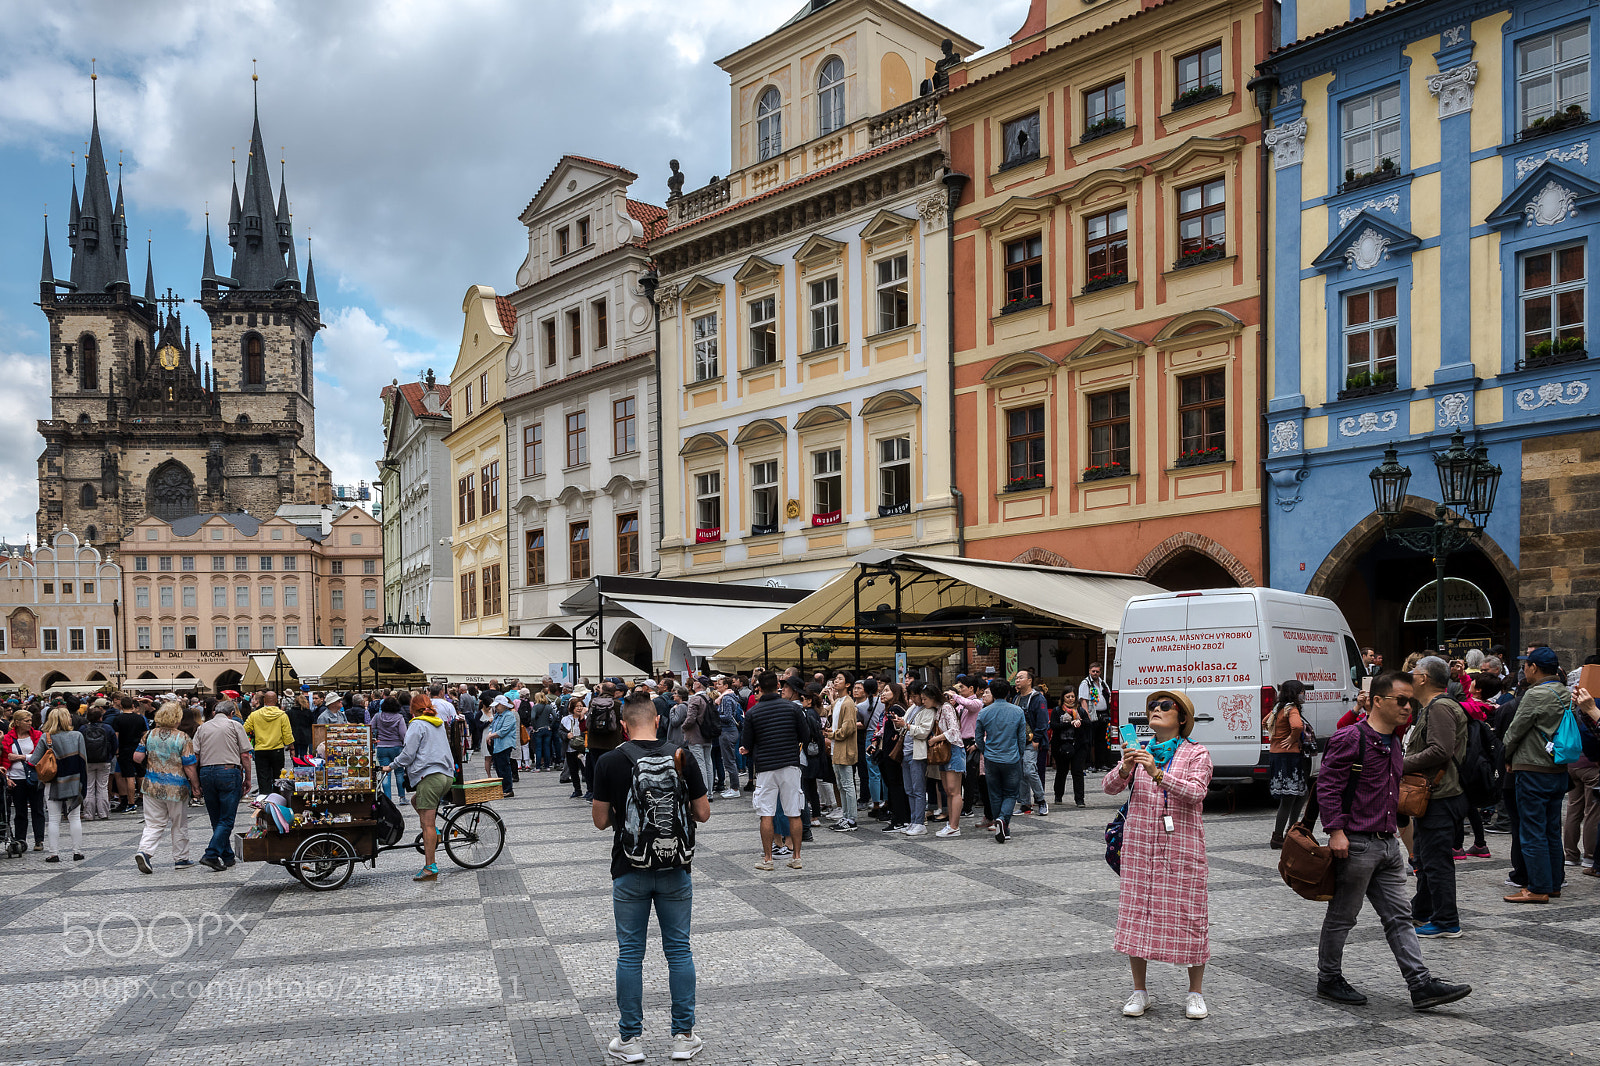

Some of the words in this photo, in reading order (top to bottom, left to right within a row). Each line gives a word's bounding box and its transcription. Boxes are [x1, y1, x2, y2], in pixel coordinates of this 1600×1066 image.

[1127, 636, 1155, 645] ROZVOZ
[1155, 635, 1178, 643] MASA,
[1178, 632, 1214, 641] MASNÝCH
[1215, 630, 1252, 640] VÝROBKŮ
[1150, 645, 1156, 653] A
[1156, 642, 1201, 652] MRAŽENÉHO
[1202, 641, 1225, 650] ZBOŽÍ
[1138, 661, 1238, 673] www.masoklasa.cz
[1127, 677, 1142, 686] tel.:
[1143, 676, 1158, 685] 603
[1160, 676, 1174, 685] 251
[1177, 675, 1195, 685] 519,
[1196, 675, 1213, 683] 603
[1214, 674, 1230, 683] 871
[1233, 673, 1250, 682] 084
